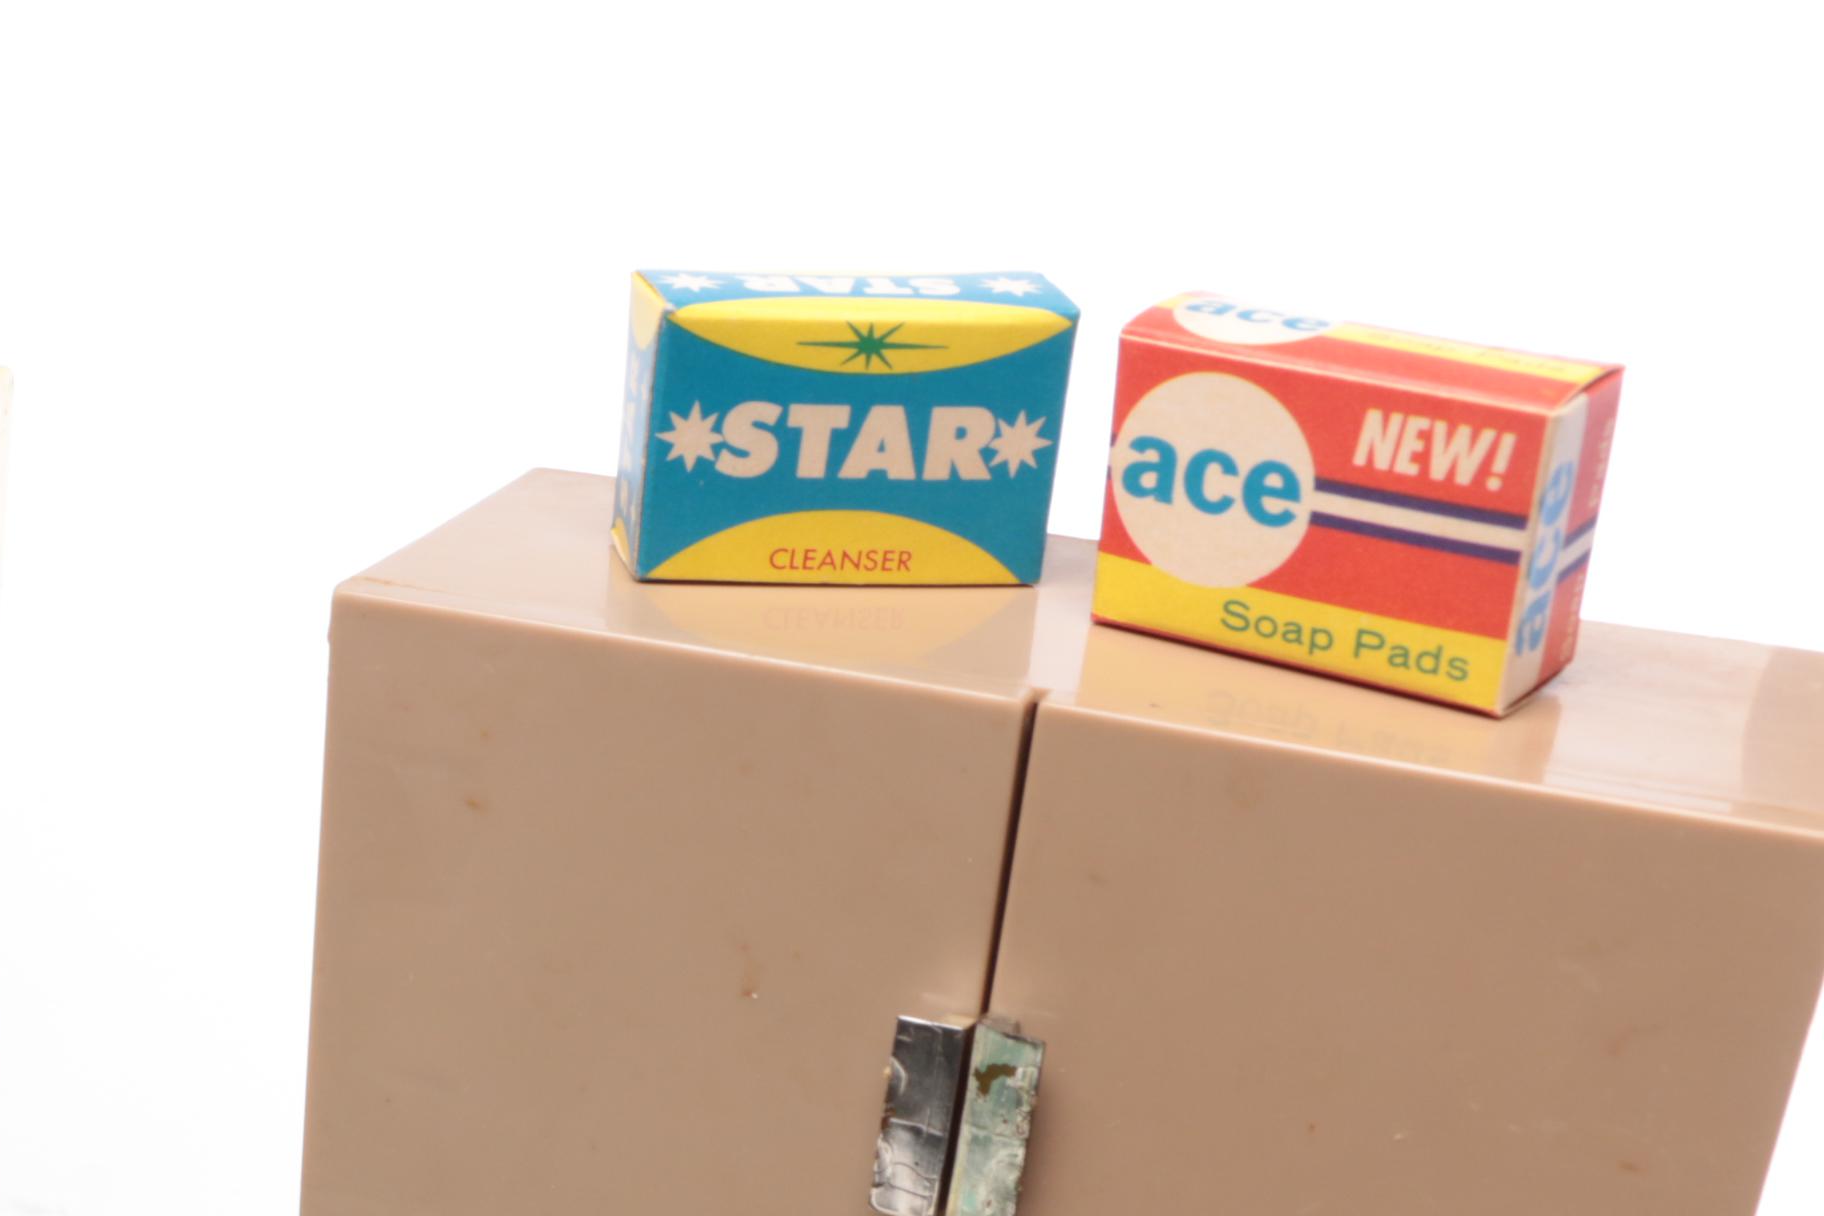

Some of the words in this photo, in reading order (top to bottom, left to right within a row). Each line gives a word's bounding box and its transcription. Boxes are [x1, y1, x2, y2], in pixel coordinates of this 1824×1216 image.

[741, 275, 961, 296] STAR
[1185, 300, 1330, 331] ace
[714, 400, 996, 481] STAR
[1121, 434, 1302, 528] ace
[1352, 408, 1517, 492] NEW!
[769, 547, 913, 572] CLEANSER
[1514, 460, 1574, 657] ace
[1220, 600, 1334, 657] Soap
[1354, 628, 1470, 683] Pads
